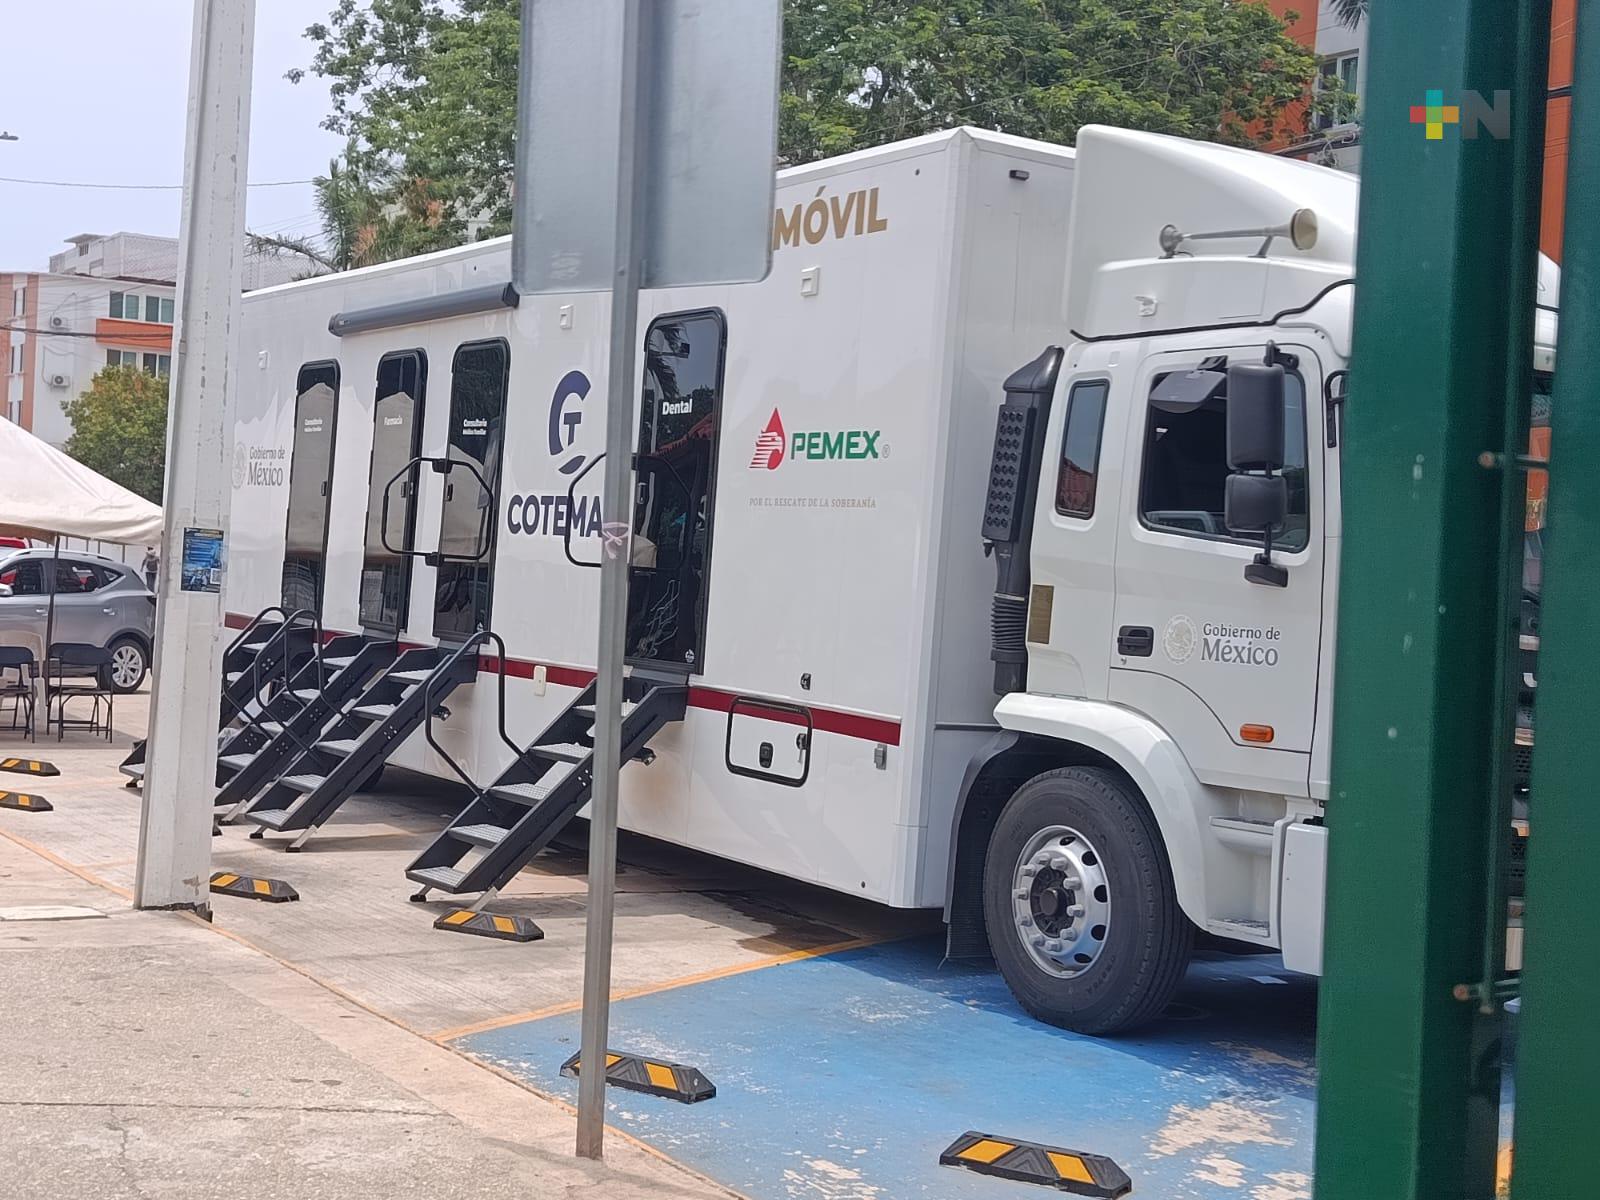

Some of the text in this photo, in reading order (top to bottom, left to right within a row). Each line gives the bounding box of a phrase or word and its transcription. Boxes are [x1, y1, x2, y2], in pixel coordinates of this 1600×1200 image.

[772, 184, 889, 252] MÓVIL
[662, 398, 693, 415] Dental
[250, 444, 286, 460] Gobierno de
[790, 430, 881, 460] PEMEX
[247, 461, 283, 487] México
[507, 494, 603, 538] COTEMA
[831, 497, 877, 509] SOBERANÍA
[1203, 623, 1281, 640] Gobierno de
[1201, 637, 1279, 667] México
